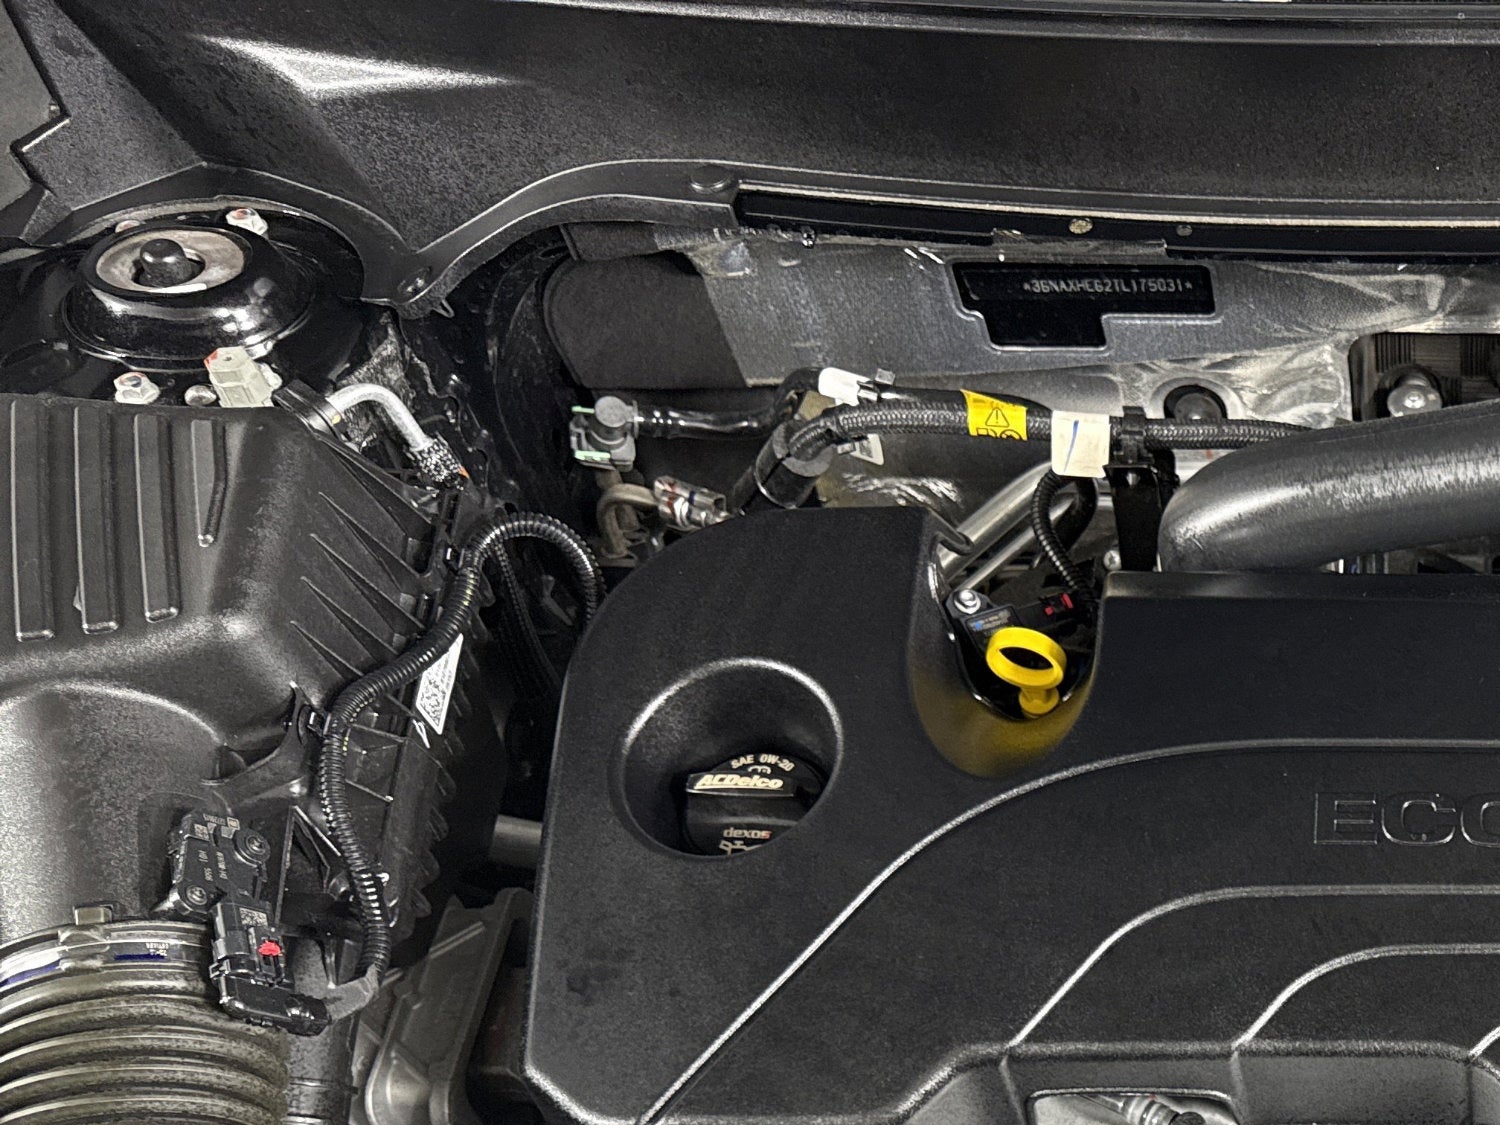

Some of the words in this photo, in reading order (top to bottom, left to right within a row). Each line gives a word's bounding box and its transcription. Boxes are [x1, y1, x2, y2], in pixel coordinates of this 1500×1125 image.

[731, 755, 755, 769] SAE
[760, 753, 795, 772] 0W-20
[694, 774, 784, 790] ACDelco
[723, 827, 773, 839] dexos
